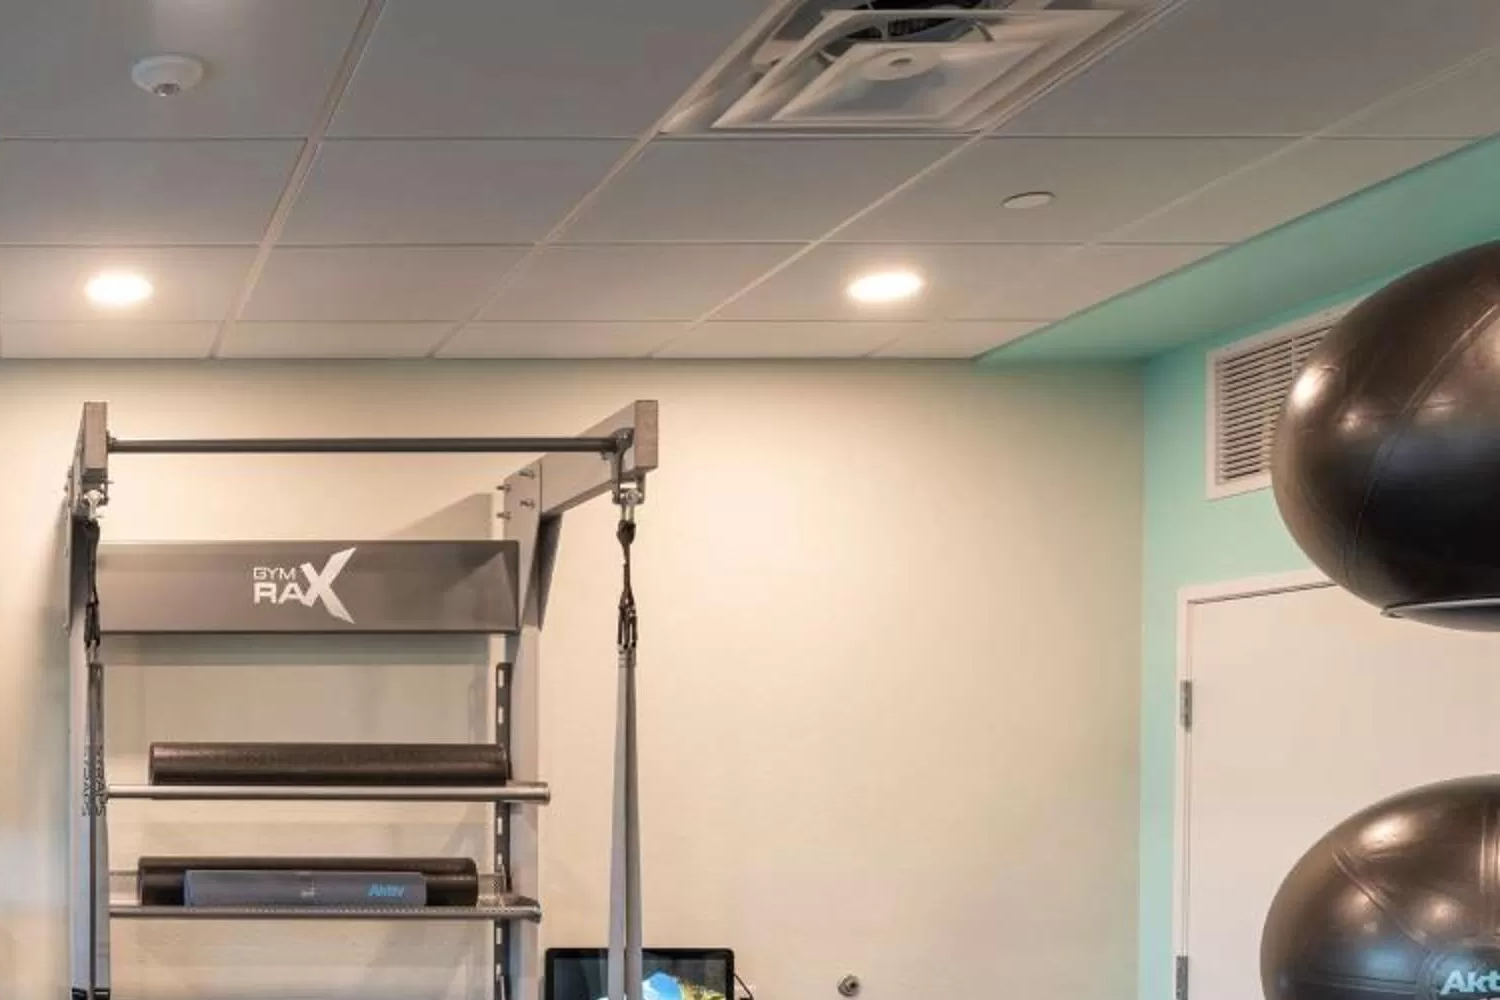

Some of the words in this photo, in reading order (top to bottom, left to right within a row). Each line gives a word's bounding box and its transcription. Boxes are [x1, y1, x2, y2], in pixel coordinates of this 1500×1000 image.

[253, 566, 297, 580] GYM
[253, 546, 357, 624] RAX
[367, 883, 405, 898] Aktiv
